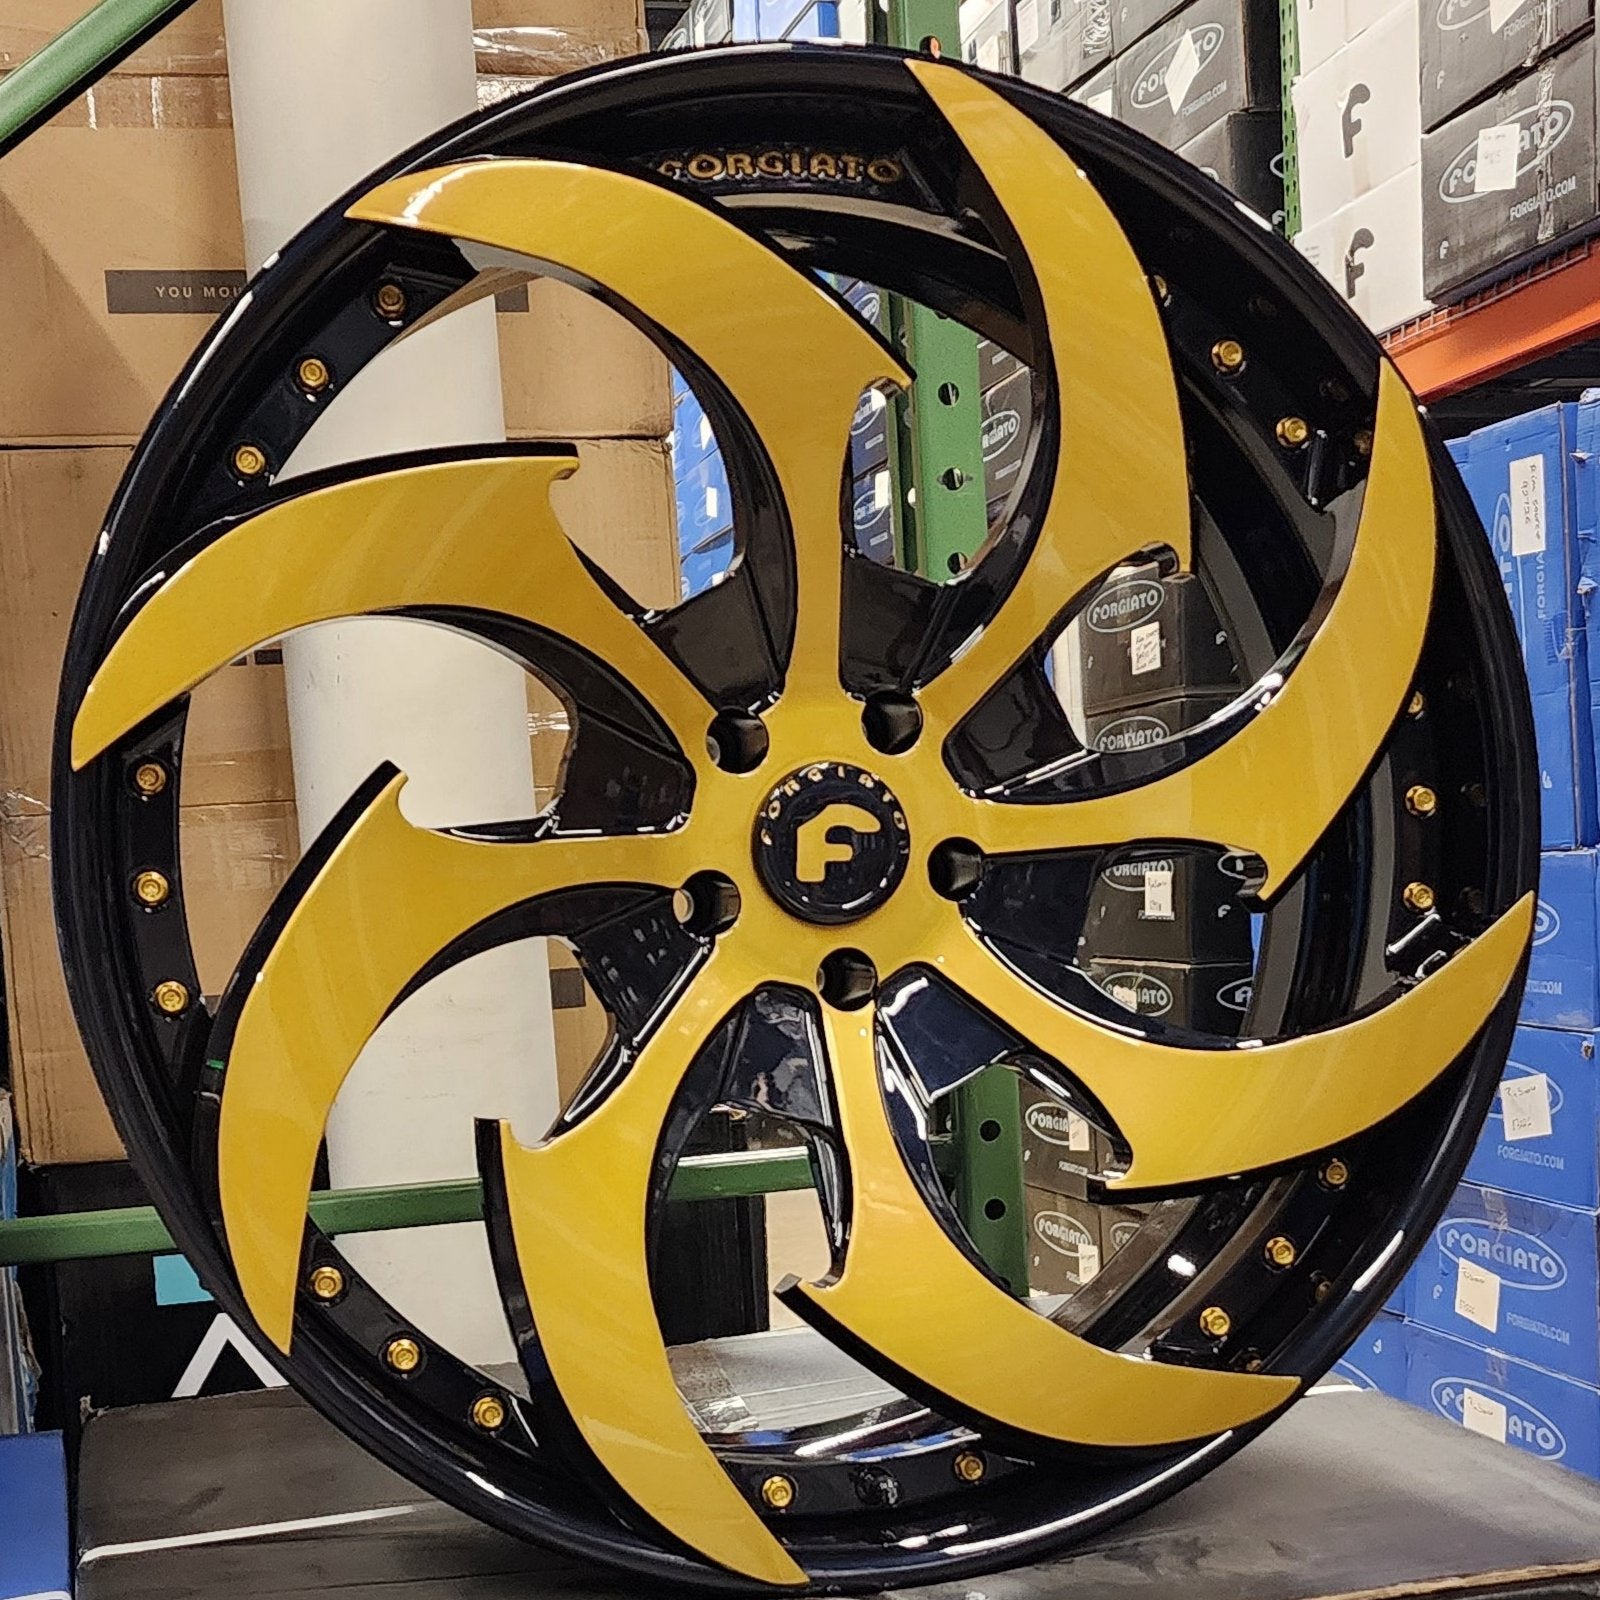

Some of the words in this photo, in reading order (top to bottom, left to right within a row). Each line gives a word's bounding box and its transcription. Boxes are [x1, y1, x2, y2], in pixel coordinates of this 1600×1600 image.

[1137, 31, 1217, 102] FOTO
[1448, 110, 1564, 194] FOATO
[1509, 175, 1576, 221] FORGIO.COM
[155, 286, 192, 298] YOU
[1092, 589, 1159, 624] FORGIATO
[1535, 551, 1547, 620] FORGIA
[1100, 726, 1164, 752] FORATO
[796, 803, 881, 883] F
[1030, 1111, 1069, 1133] FORGIA
[1446, 1228, 1558, 1279] FORGIATO
[1441, 1386, 1556, 1450] FATO
